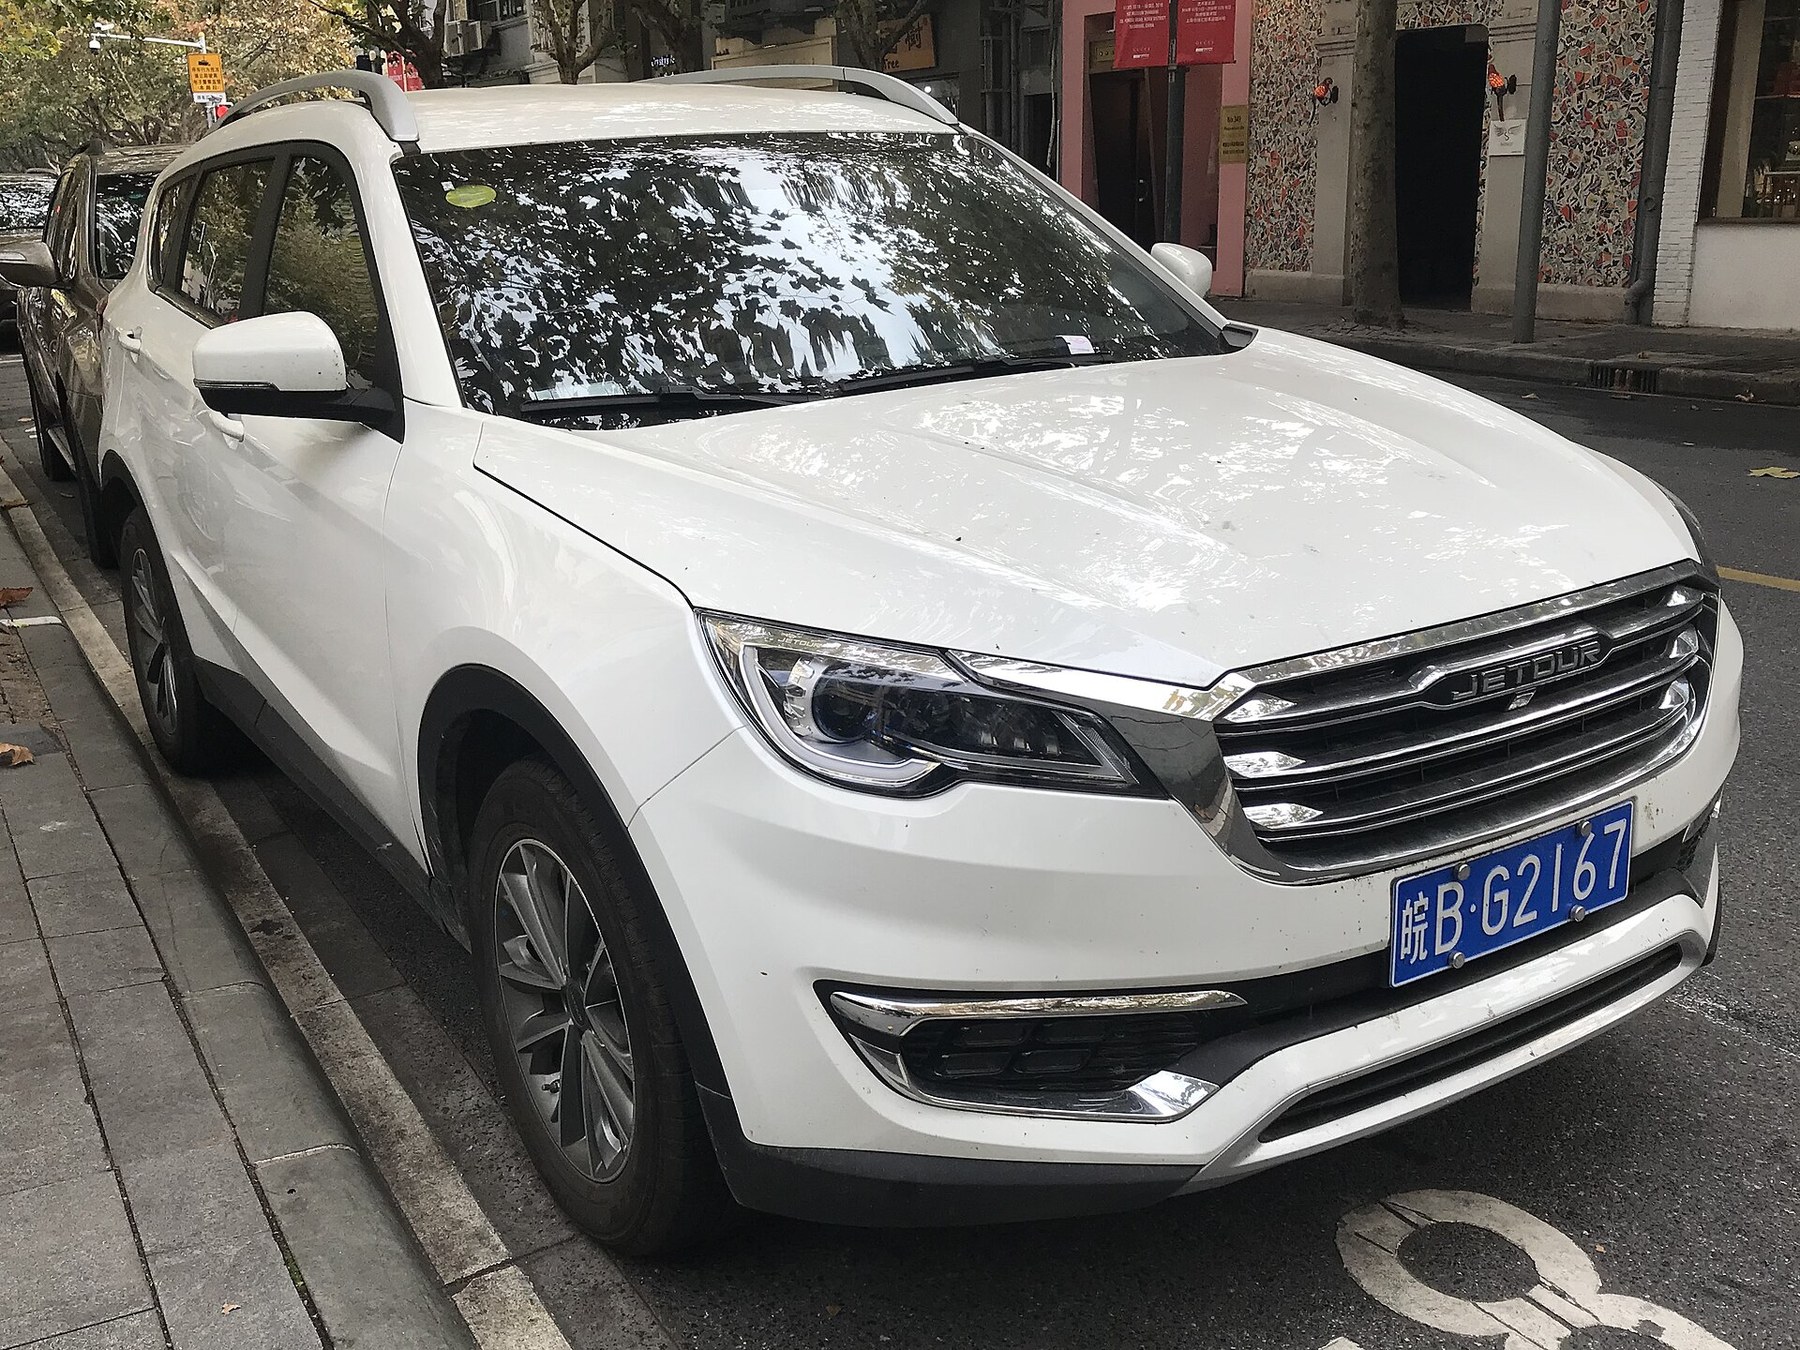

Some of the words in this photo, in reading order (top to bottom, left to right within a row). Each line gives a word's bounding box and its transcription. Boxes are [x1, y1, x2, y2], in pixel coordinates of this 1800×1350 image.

[777, 637, 822, 648] JETOUR
[1452, 641, 1600, 700] JETOUR
[1400, 818, 1627, 964] 皖B·G2167
